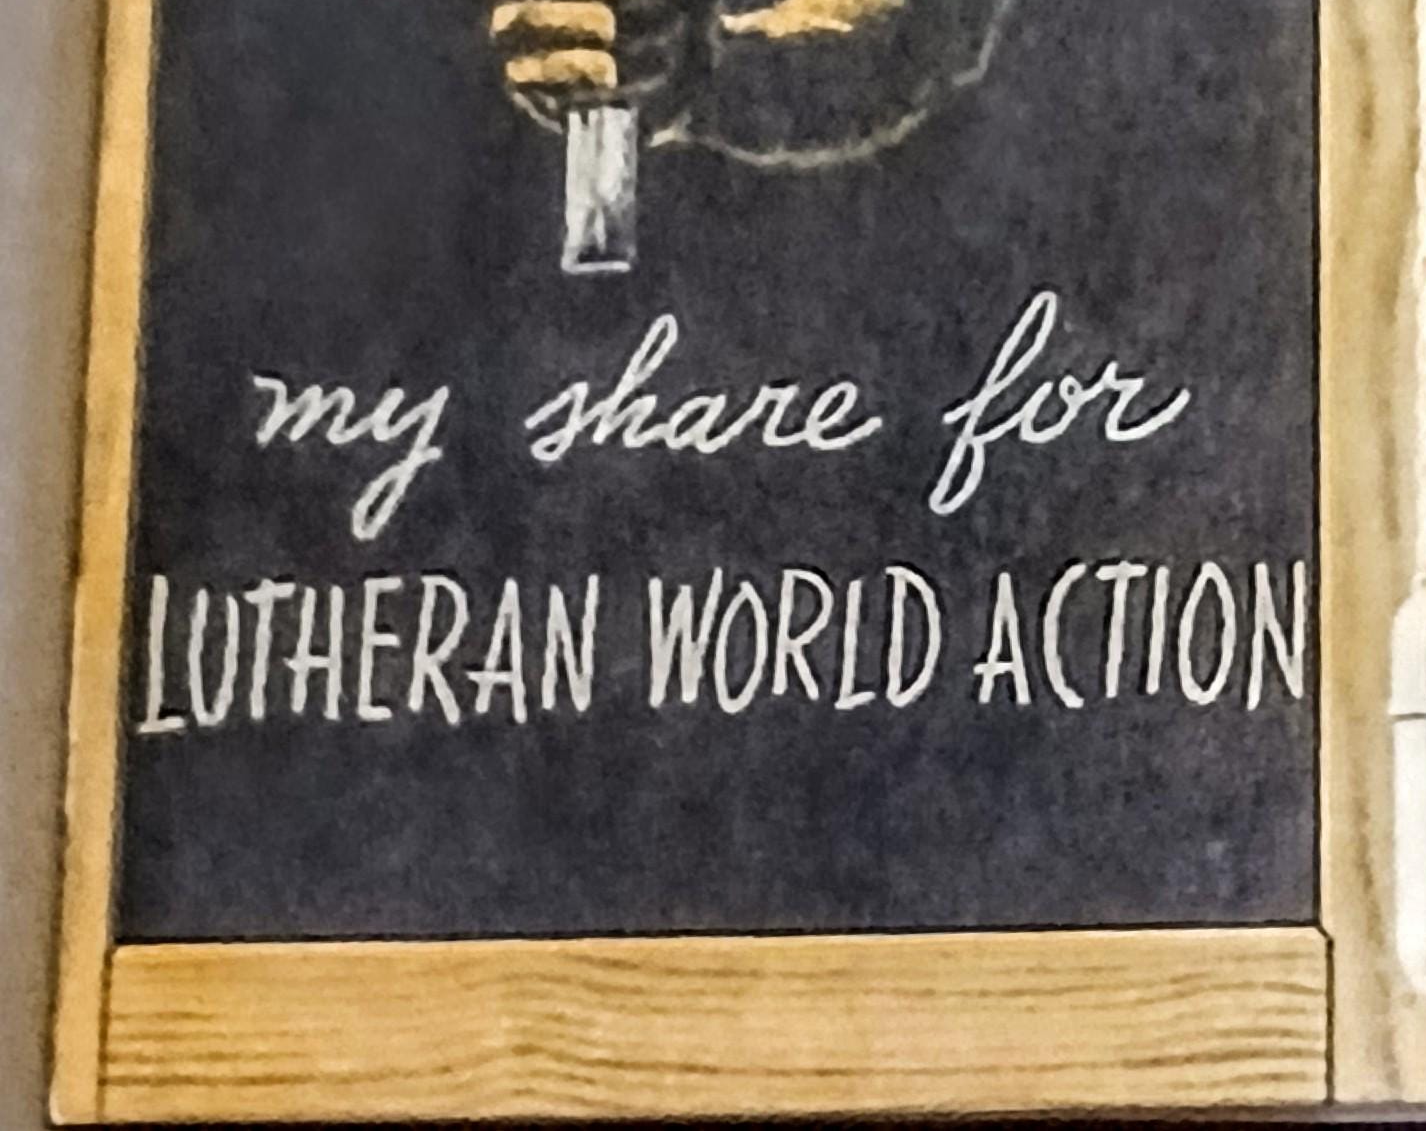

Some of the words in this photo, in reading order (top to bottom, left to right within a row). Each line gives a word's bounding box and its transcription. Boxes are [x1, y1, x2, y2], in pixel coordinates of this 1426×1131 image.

[254, 376, 449, 540] my
[524, 314, 882, 462] share
[930, 291, 1190, 515] for
[139, 574, 598, 732] LUTHERAN
[649, 566, 941, 714] WORLD
[974, 561, 1307, 708] ACTION
